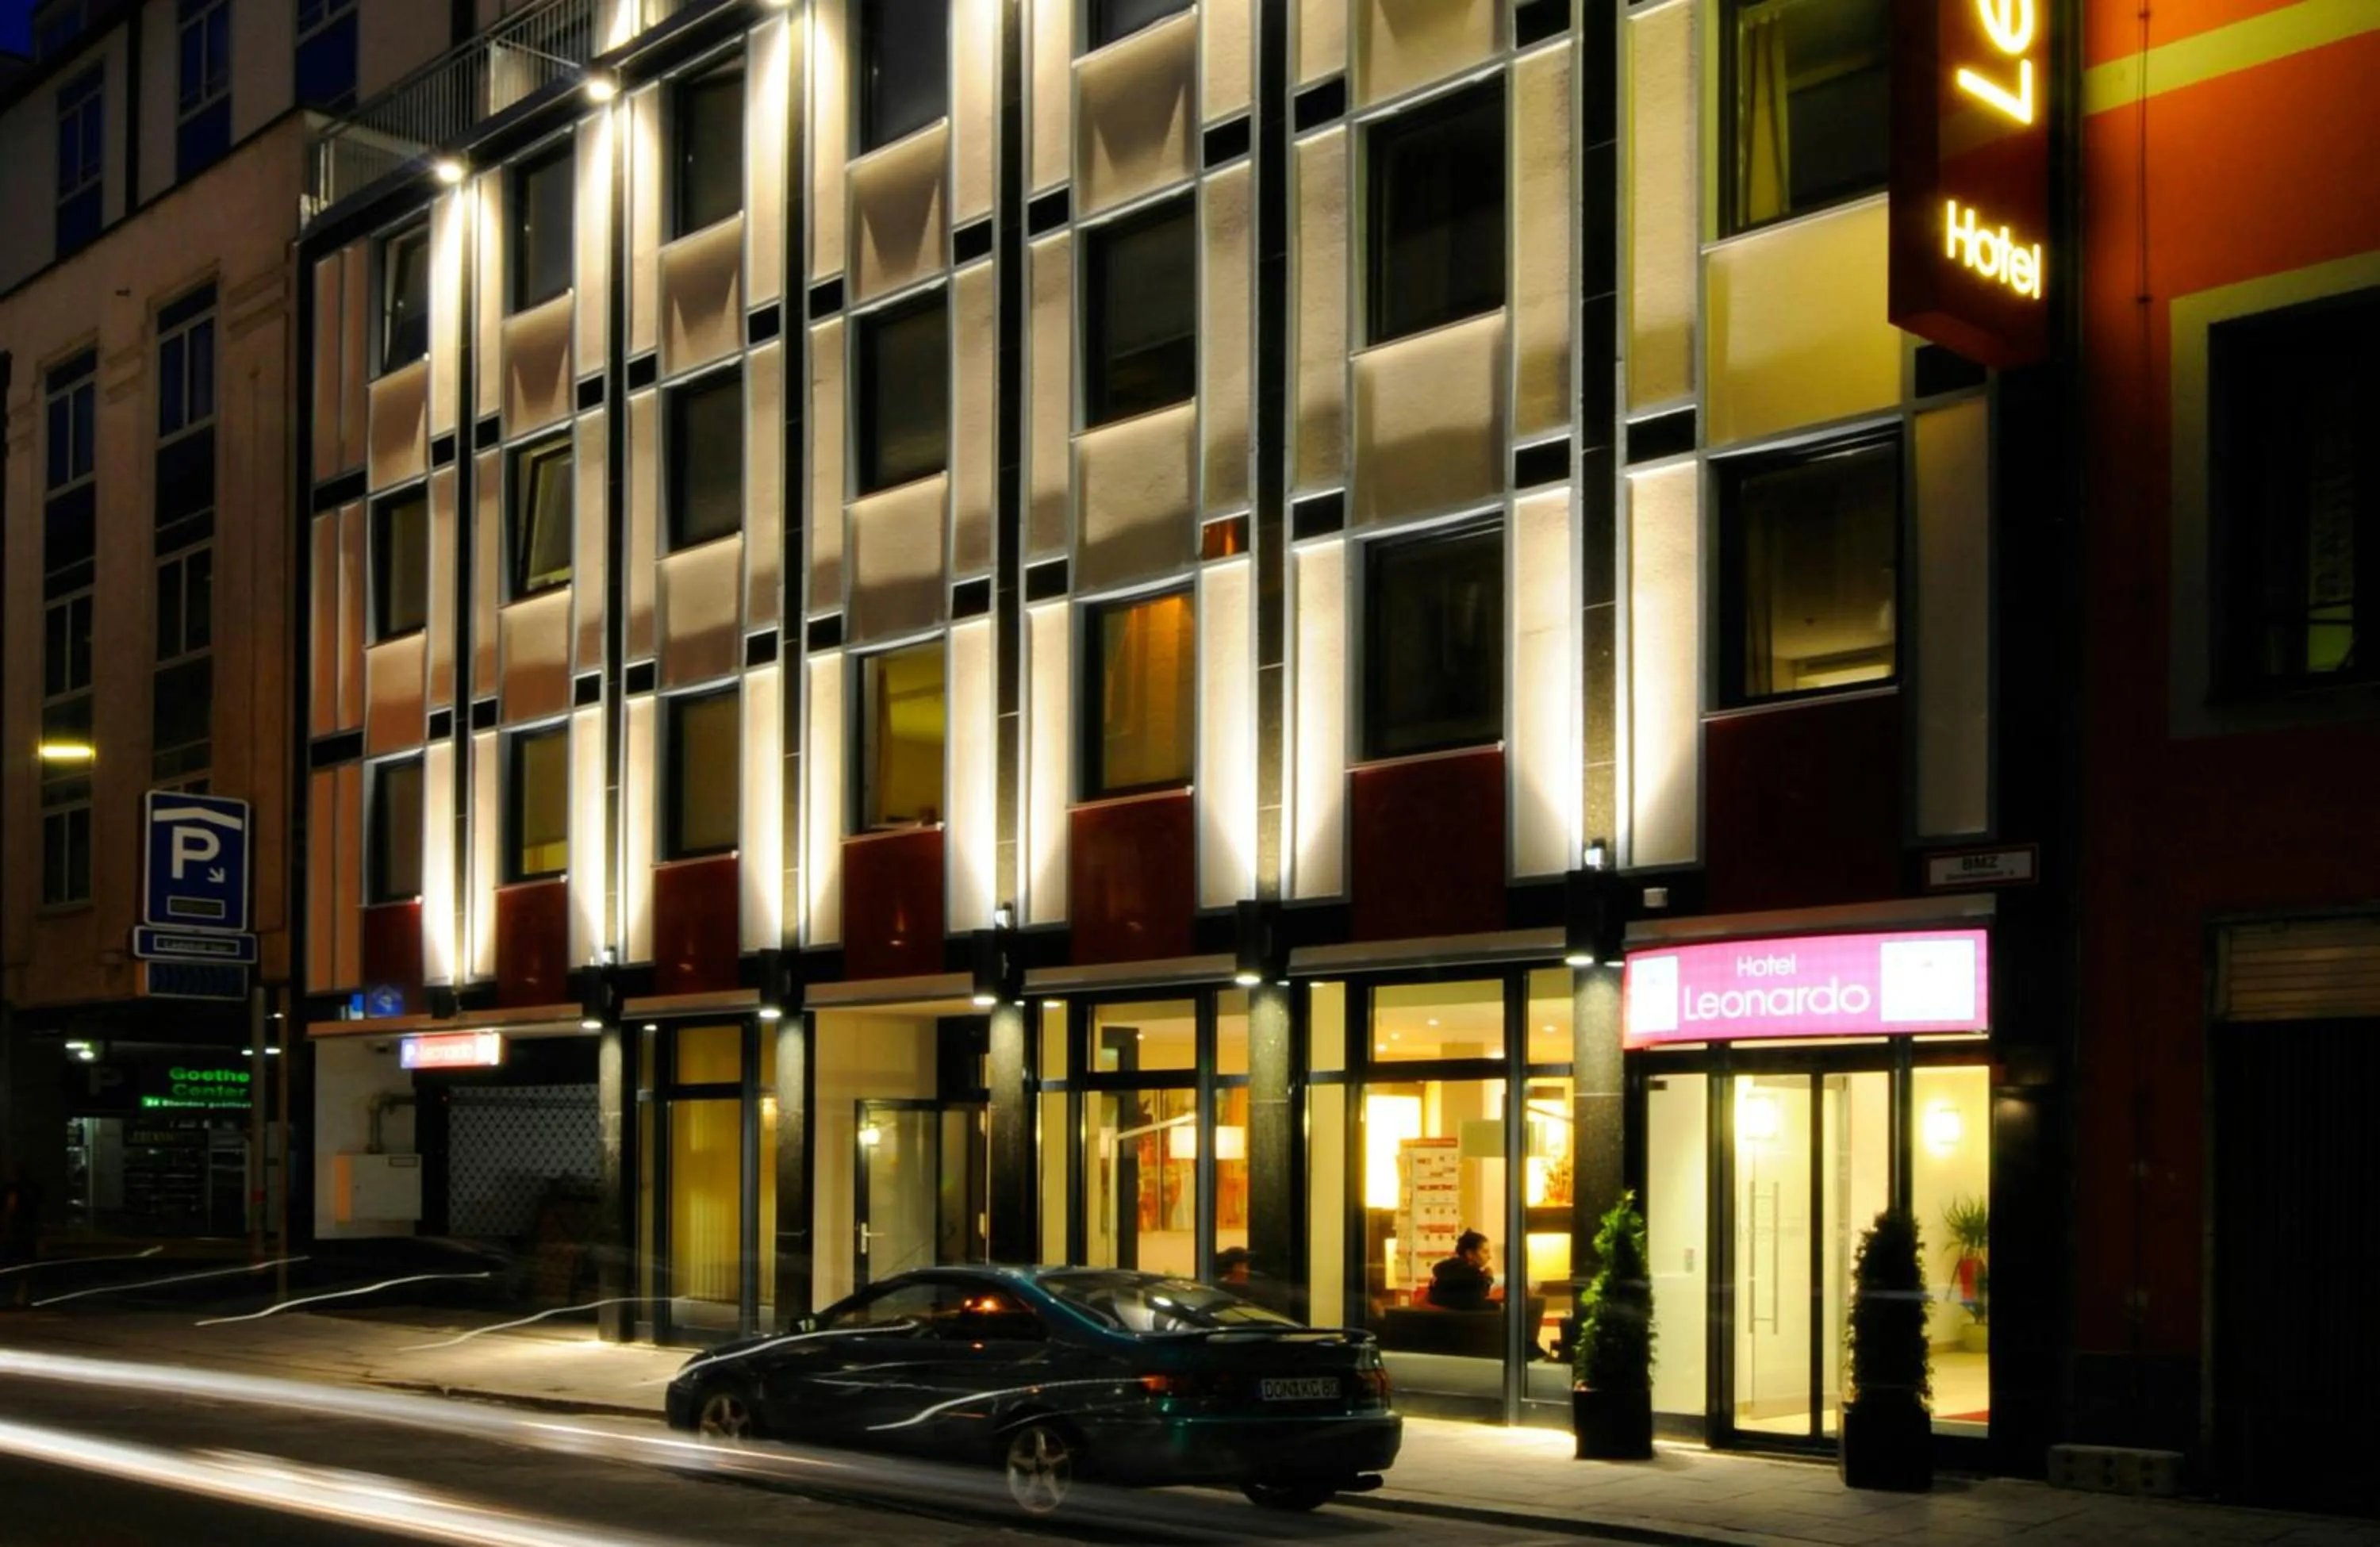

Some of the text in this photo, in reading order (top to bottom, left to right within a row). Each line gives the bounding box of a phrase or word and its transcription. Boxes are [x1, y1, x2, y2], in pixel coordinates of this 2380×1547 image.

[1946, 199, 2042, 301] Hotel
[171, 825, 221, 879] P
[1737, 953, 1797, 978] Hotel
[1683, 977, 1871, 1021] Leonardo
[168, 1066, 251, 1083] Goethe
[171, 1083, 248, 1098] Center
